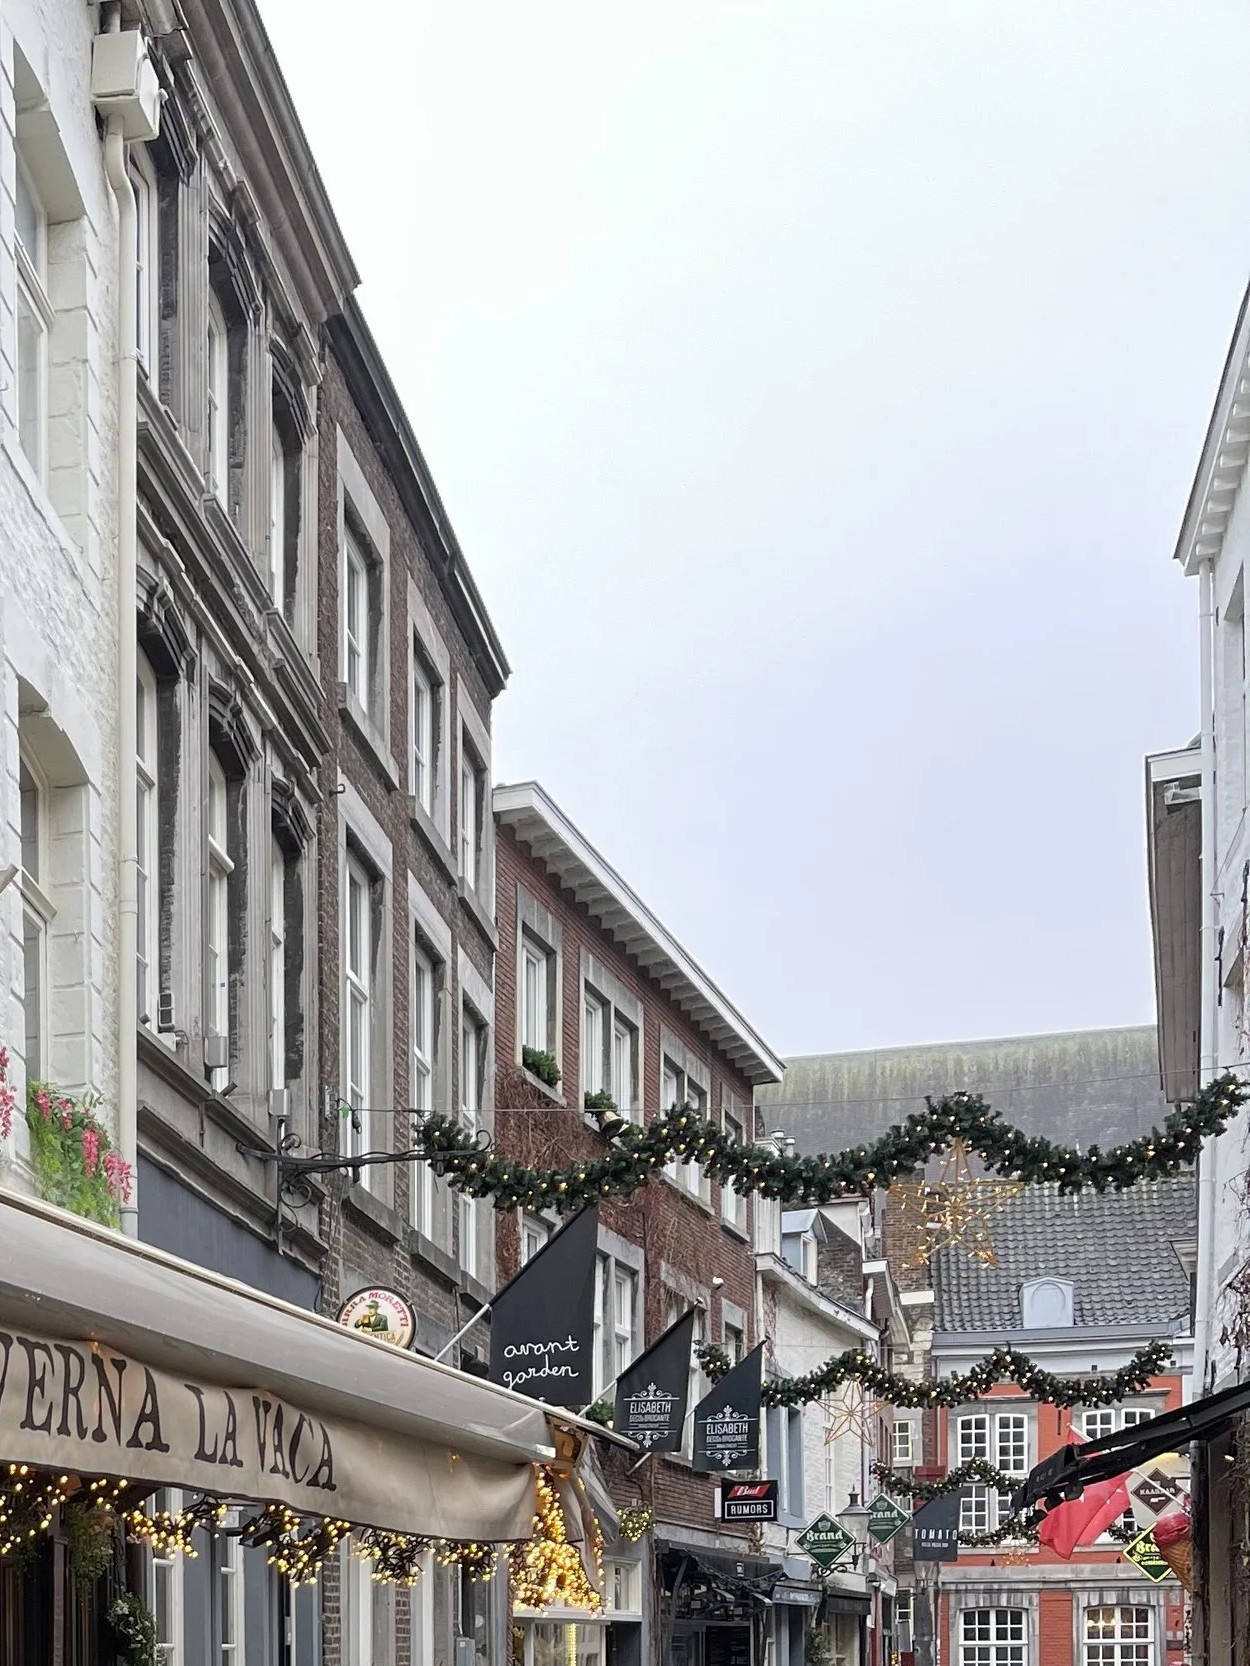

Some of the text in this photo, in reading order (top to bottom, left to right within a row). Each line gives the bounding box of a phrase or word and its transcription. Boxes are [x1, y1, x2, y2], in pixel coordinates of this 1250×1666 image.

[368, 1292, 409, 1327] MORETTI
[504, 1335, 580, 1357] avant
[503, 1354, 579, 1390] garden
[629, 1401, 671, 1414] ELISABETH
[706, 1422, 748, 1435] ELISABETH
[184, 1384, 244, 1468] LA
[252, 1395, 337, 1492] VACA
[735, 1485, 759, 1496] Bud
[1139, 1487, 1175, 1495] KAASAR
[730, 1504, 768, 1515] RUMORS
[806, 1529, 843, 1542] Brand
[915, 1528, 957, 1540] TOMATO
[1136, 1540, 1160, 1553] Bra
